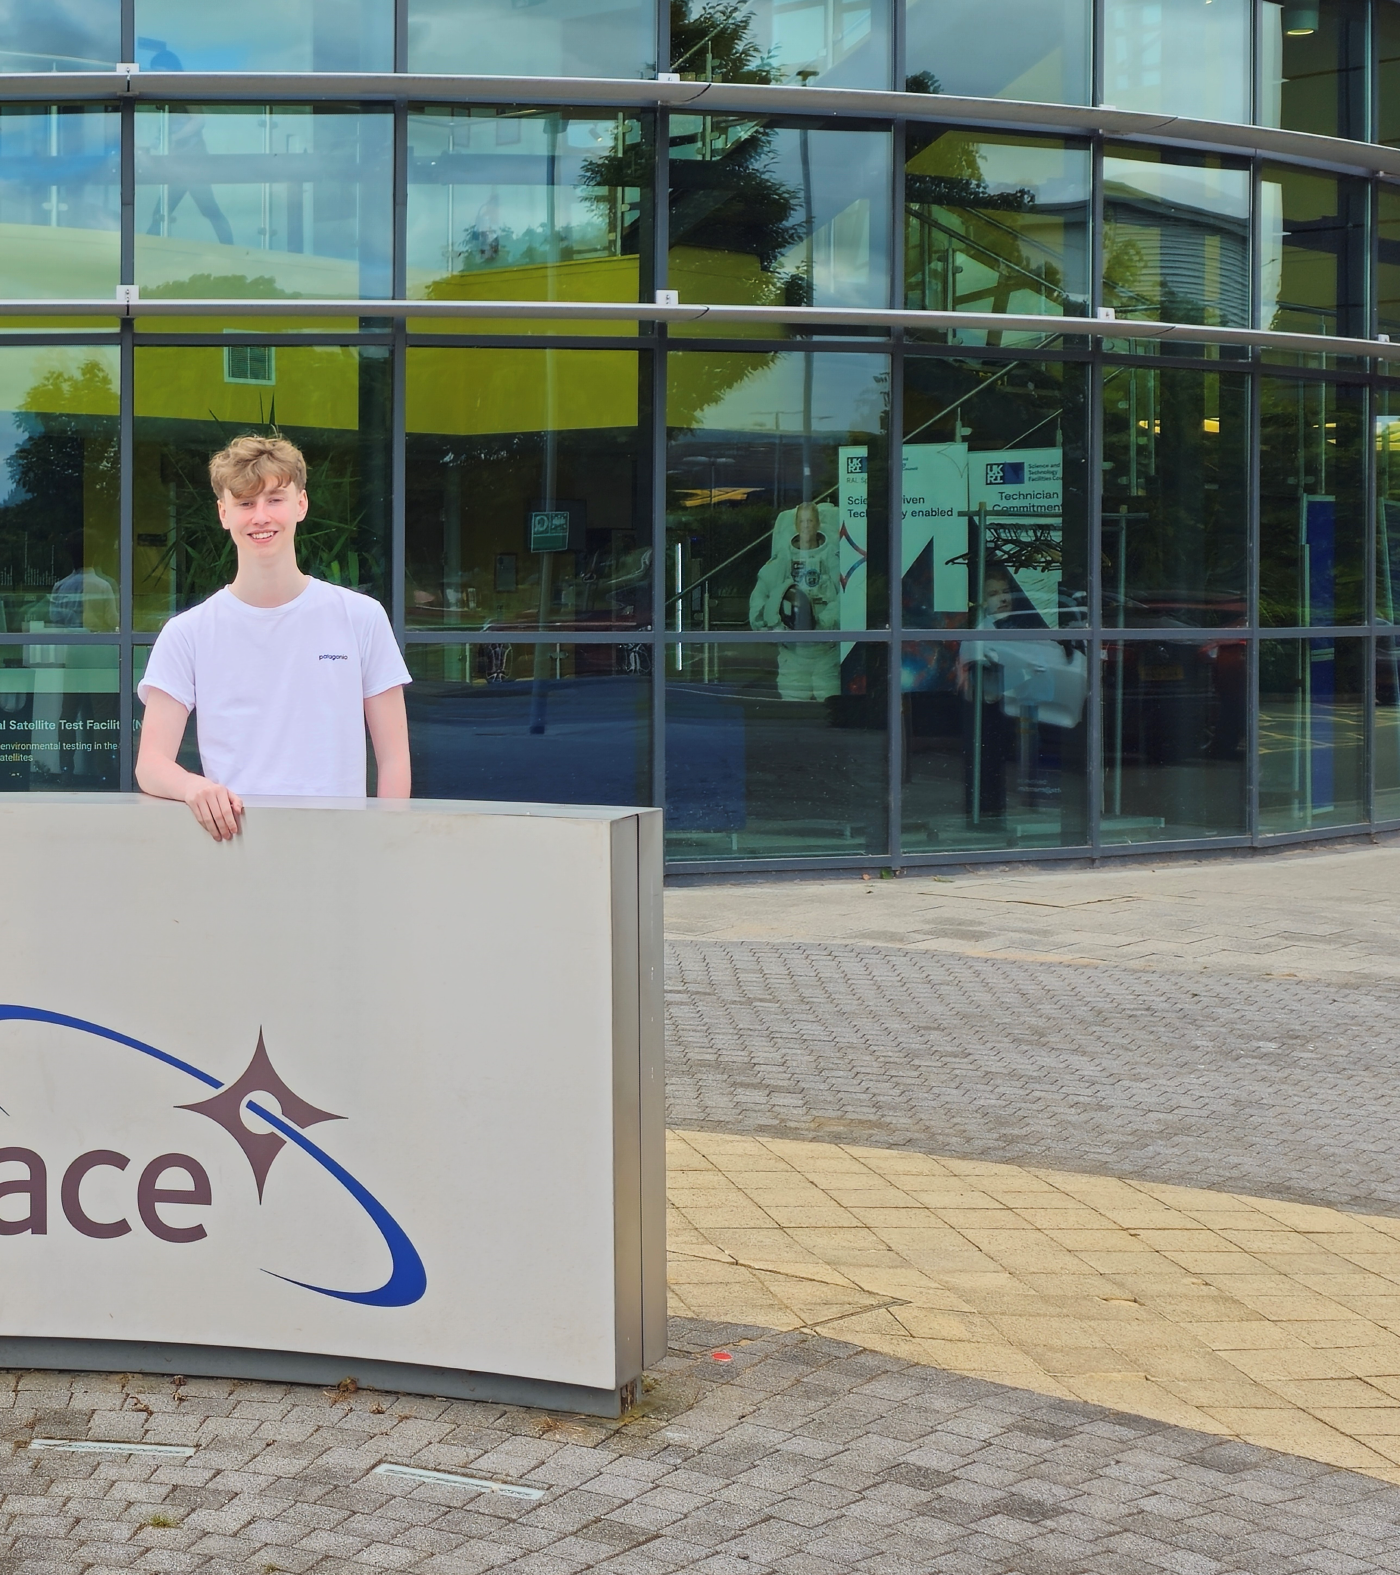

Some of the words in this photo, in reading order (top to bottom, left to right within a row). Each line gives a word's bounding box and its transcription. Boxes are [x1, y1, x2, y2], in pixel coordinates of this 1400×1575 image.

[998, 489, 1059, 501] Technician
[911, 507, 954, 517] enabled
[9, 719, 56, 730] Satellite
[59, 719, 83, 730] Test
[0, 741, 61, 751] environmental
[62, 742, 92, 752] testing
[94, 741, 102, 750] in
[104, 741, 118, 750] the
